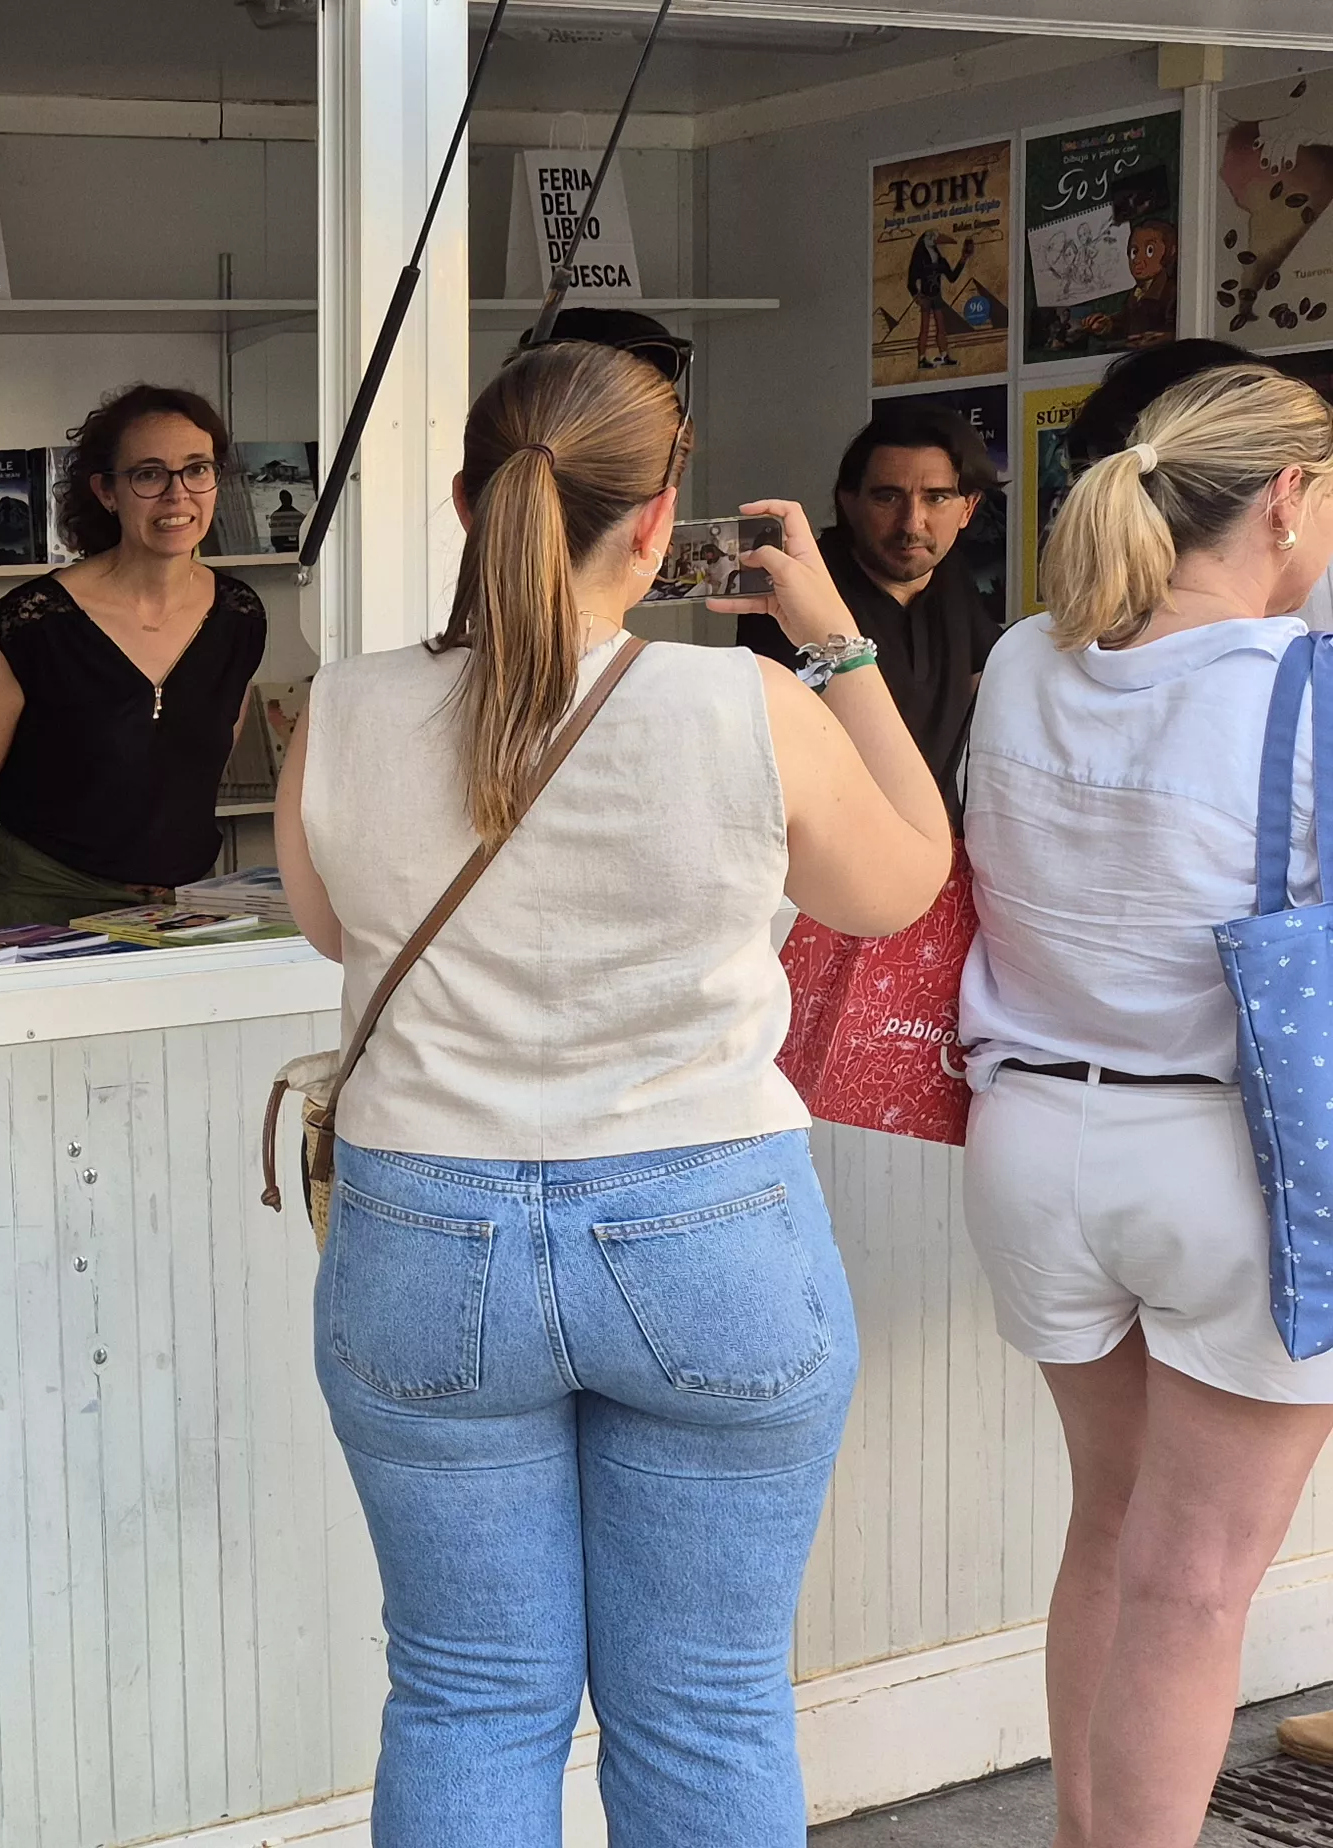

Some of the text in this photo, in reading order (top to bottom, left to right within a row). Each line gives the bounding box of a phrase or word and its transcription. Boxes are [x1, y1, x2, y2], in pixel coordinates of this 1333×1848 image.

[1091, 153, 1097, 161] y
[538, 168, 594, 191] FERIA
[889, 169, 989, 213] TOTHY
[1041, 154, 1140, 211] Goya
[541, 192, 577, 215] DEL
[551, 264, 631, 287] UESCA
[969, 301, 983, 312] 96
